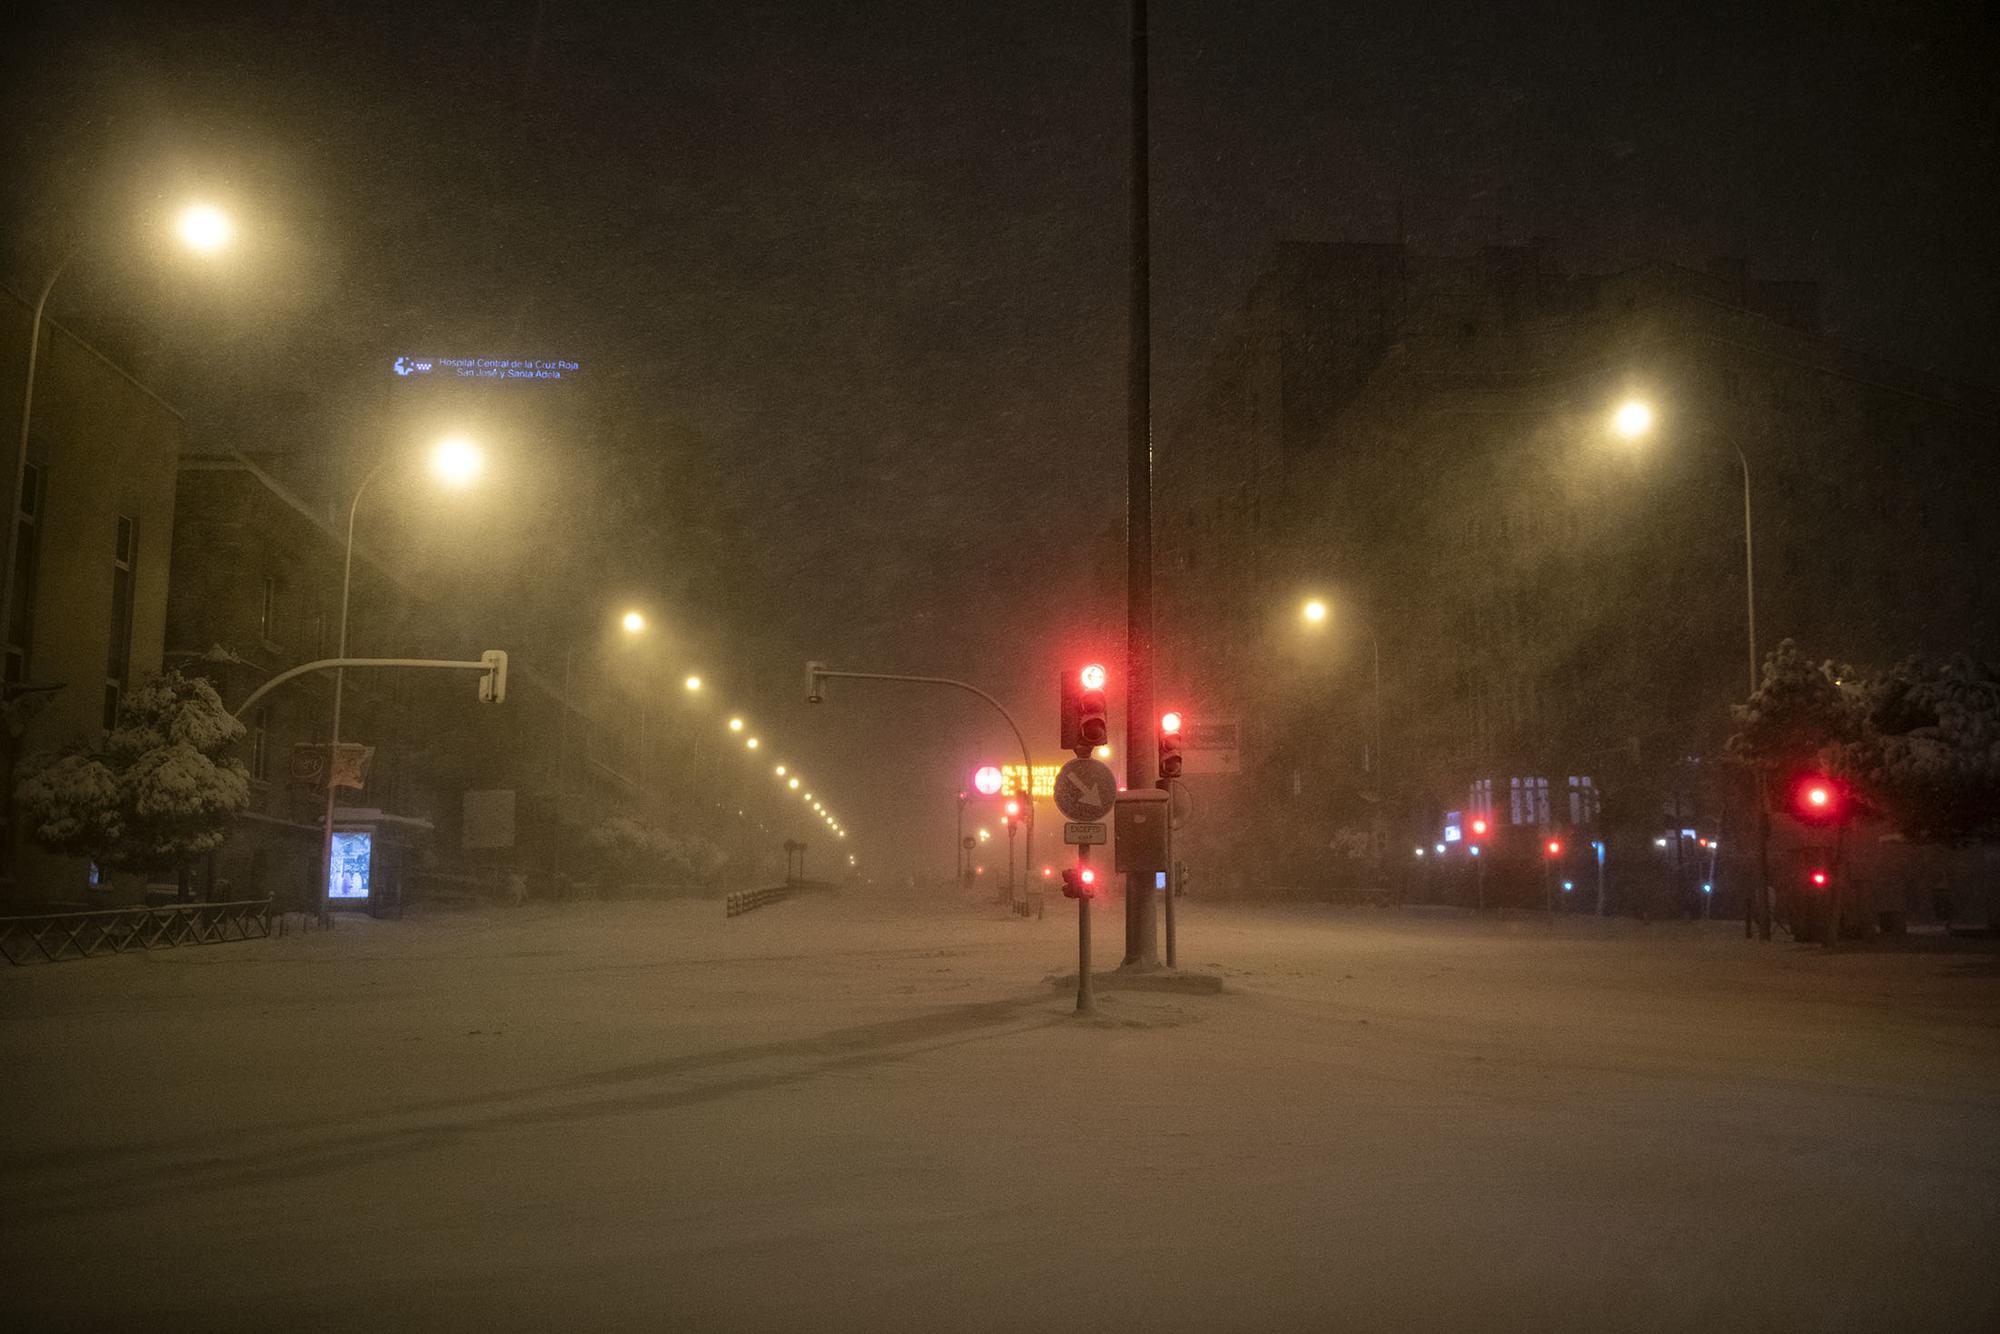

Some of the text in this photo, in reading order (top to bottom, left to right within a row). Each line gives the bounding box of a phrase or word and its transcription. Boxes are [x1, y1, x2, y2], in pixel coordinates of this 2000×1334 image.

[439, 359, 579, 371] Hospital Central de la Cruz Roja
[456, 367, 561, 379] San José y Santa Adela
